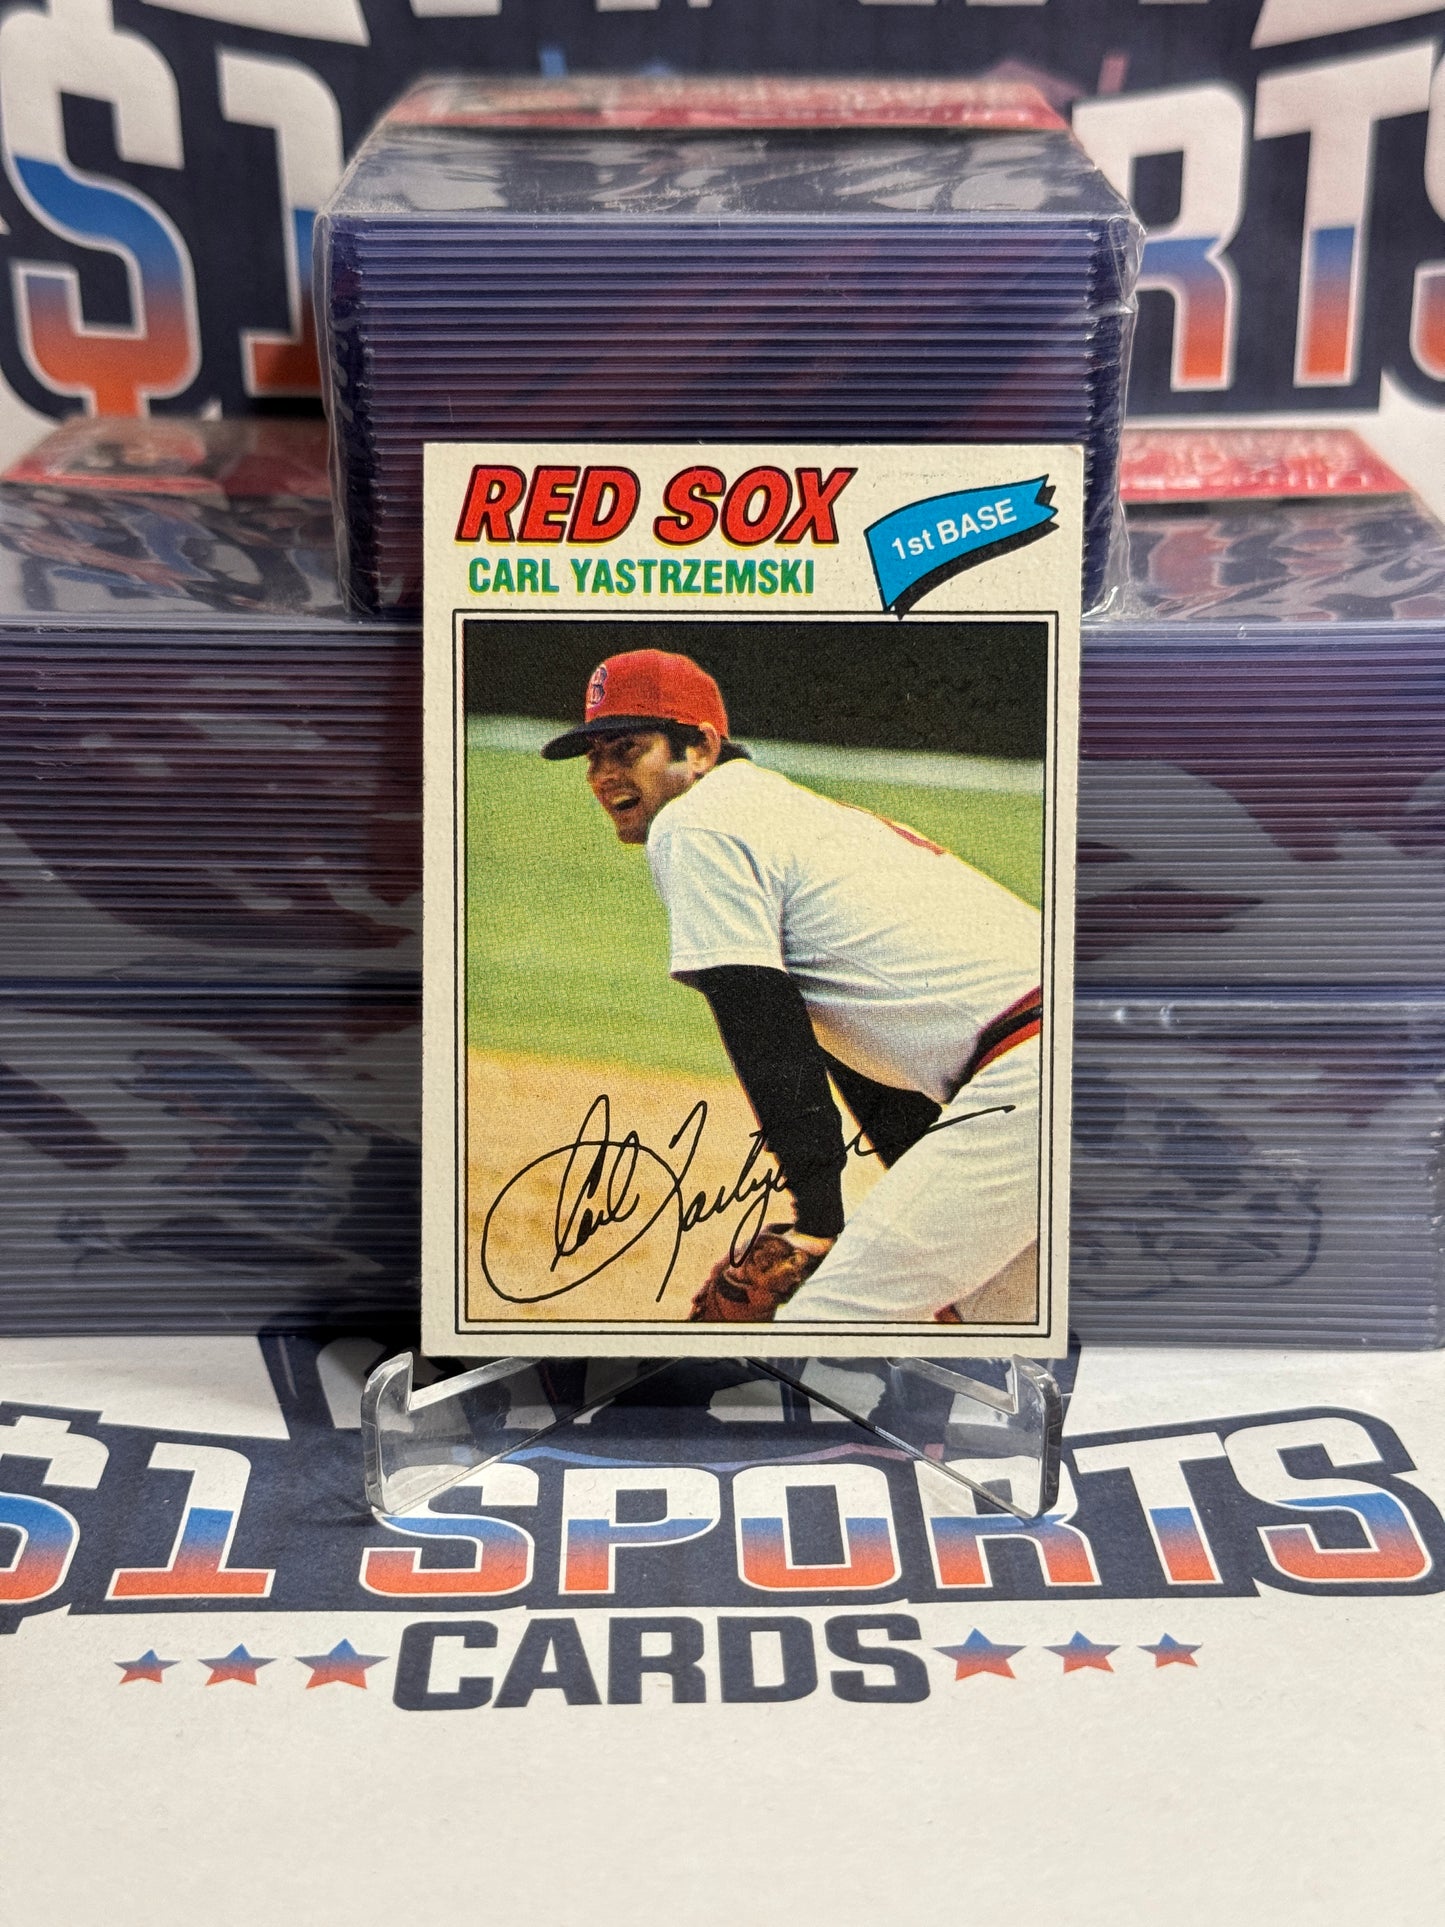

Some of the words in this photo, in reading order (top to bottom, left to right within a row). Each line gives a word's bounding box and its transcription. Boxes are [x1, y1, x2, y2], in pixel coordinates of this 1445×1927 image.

[456, 465, 640, 543] RED
[654, 467, 857, 545] SOX
[891, 526, 935, 561] 1st
[938, 498, 1018, 548] BASE
[468, 558, 560, 595] CARL
[572, 558, 815, 596] YASTRZEMSKI
[359, 1417, 1433, 1598] SPORTS
[393, 1613, 931, 1711] CARDS
